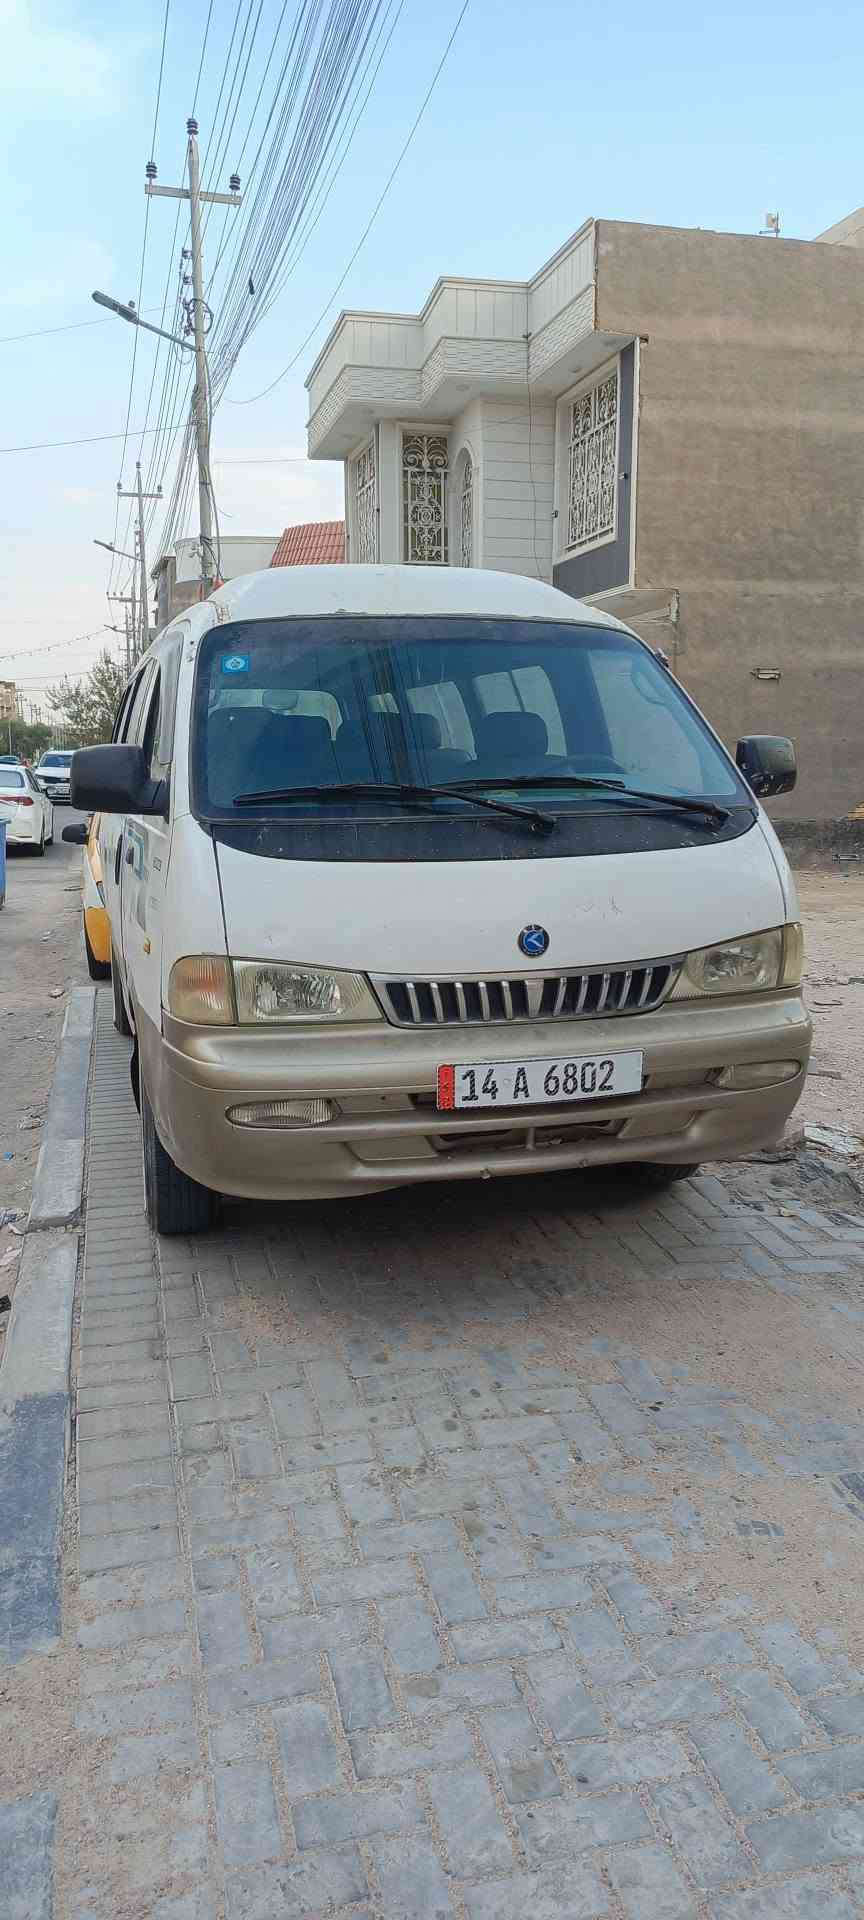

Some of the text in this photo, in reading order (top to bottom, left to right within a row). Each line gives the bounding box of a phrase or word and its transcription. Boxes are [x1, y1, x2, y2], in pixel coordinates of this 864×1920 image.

[461, 1069, 498, 1101] 14
[513, 1067, 530, 1099] A
[543, 1060, 614, 1096] 6802
